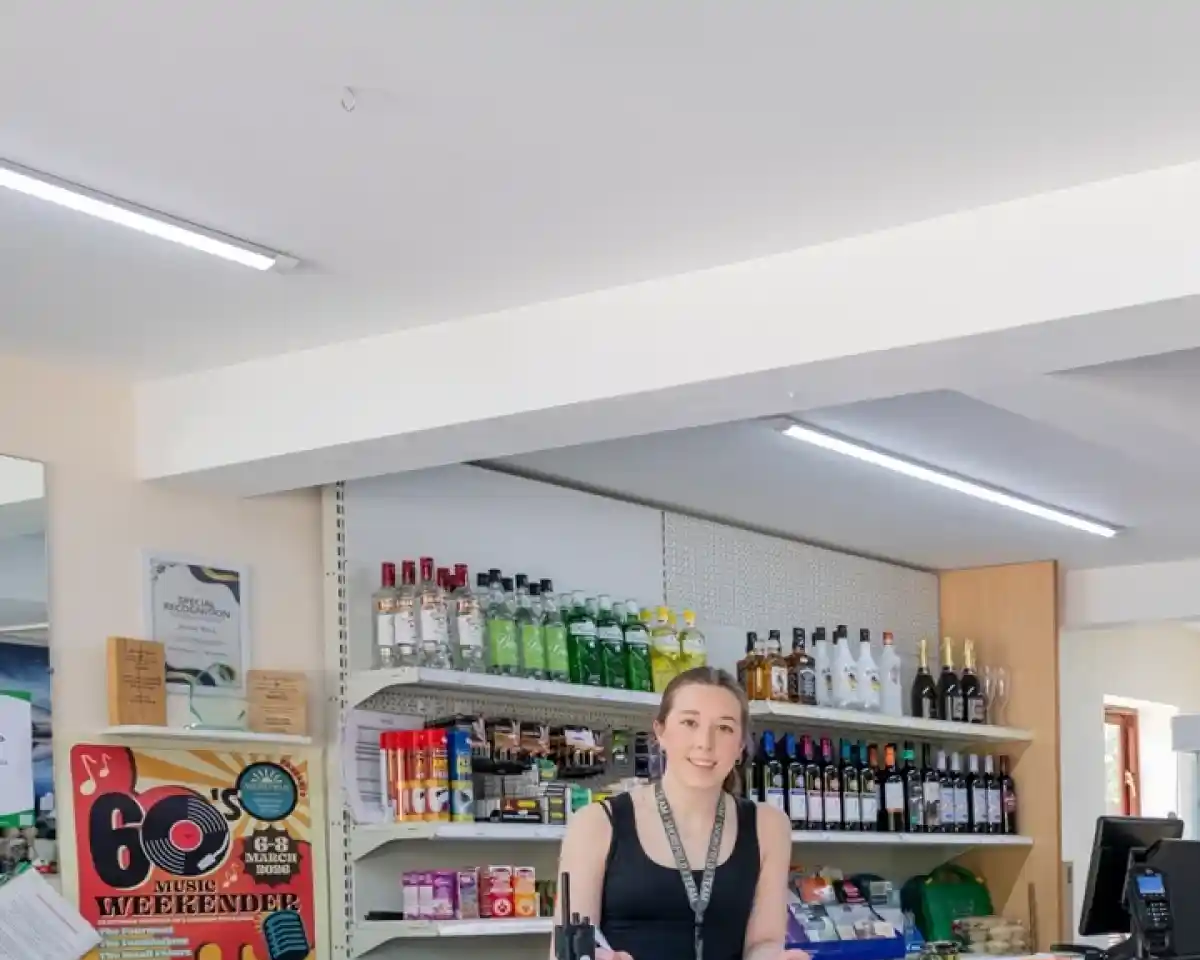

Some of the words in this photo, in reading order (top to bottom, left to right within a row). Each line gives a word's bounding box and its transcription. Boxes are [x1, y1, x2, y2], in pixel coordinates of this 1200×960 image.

[254, 835, 289, 852] 6-8
[245, 852, 298, 863] MARCH
[153, 879, 216, 893] MUSIC
[95, 893, 300, 916] WEEKENDER
